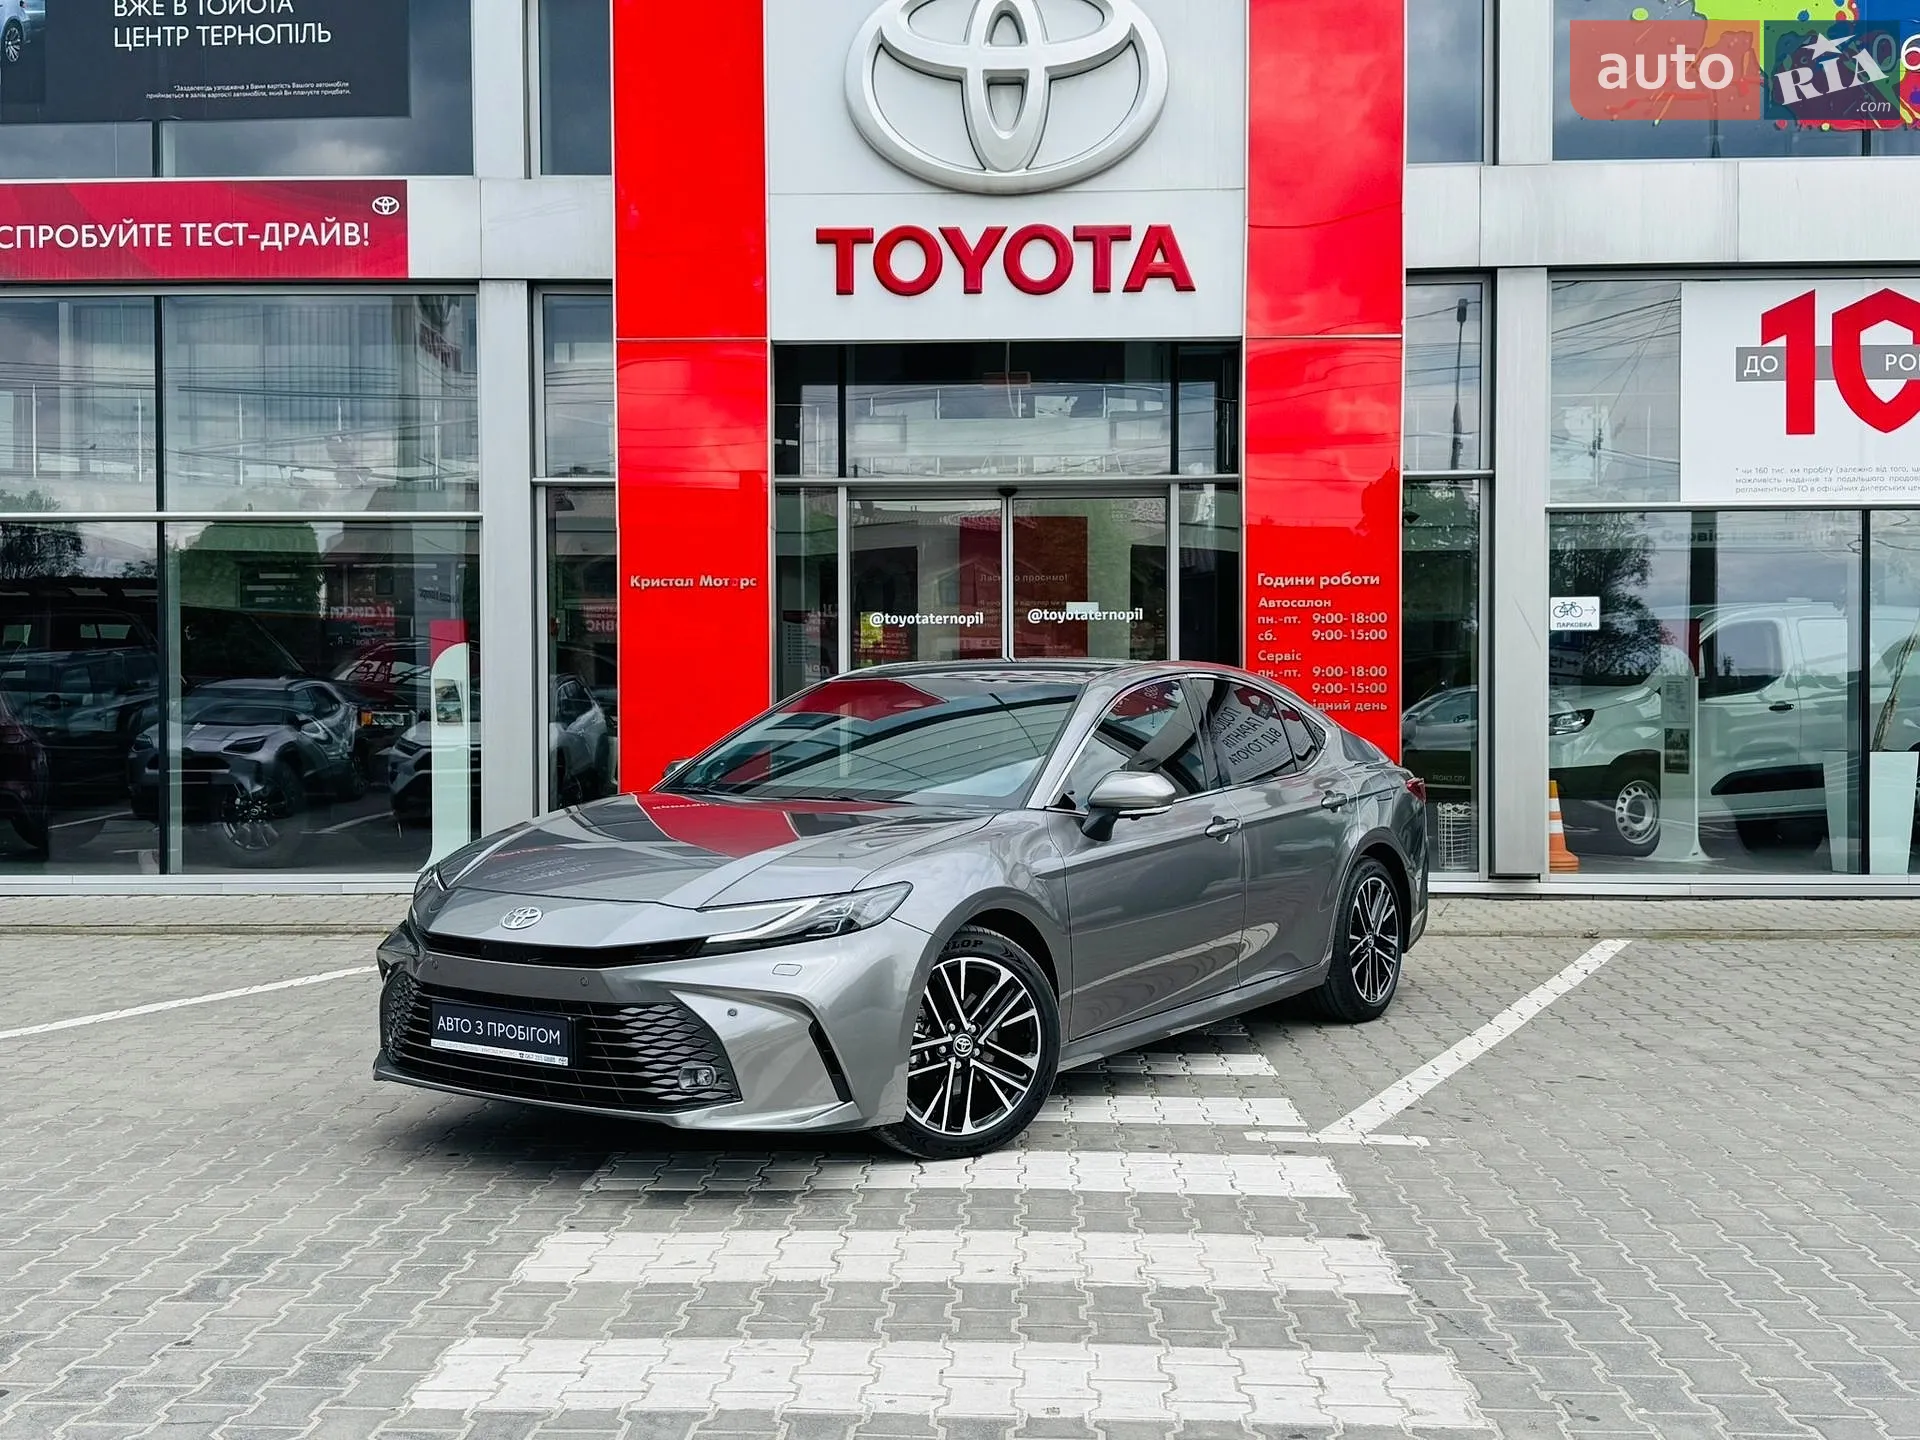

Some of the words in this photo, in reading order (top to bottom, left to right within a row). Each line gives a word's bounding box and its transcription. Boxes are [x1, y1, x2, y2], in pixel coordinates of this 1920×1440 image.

[114, 0, 165, 17] ВЖЕ
[173, 0, 188, 16] В
[114, 26, 190, 52] ЦЕНТР
[196, 23, 332, 47] ТЕРНОПІЛЬ
[0, 218, 173, 249] СПРОБУЙТЕ
[180, 216, 371, 252] ТЕСТ-ДРАЙВ!
[816, 223, 1197, 297] TOYOTA
[1743, 355, 1779, 377] ДО
[1761, 287, 1920, 436] 10
[1885, 353, 1920, 371] РО
[629, 575, 694, 590] Кристал
[1257, 572, 1315, 588] Години
[1319, 571, 1380, 589] роботи
[1257, 597, 1332, 608] Автосалон
[869, 611, 984, 627] @toyotaternopil
[1027, 607, 1144, 624] @toyotaternopil
[1312, 612, 1388, 624] 9:00-18:00
[1556, 621, 1593, 629] ПАРКОВКА
[1257, 629, 1278, 641] сб.
[1311, 629, 1388, 641] 9:00-15:00
[1257, 649, 1302, 664] Сервіс
[1312, 665, 1388, 678] 9:00-18:00
[1311, 682, 1388, 694] 9:00-15:00
[1312, 699, 1351, 712] ідний
[1354, 702, 1388, 712] день
[437, 1015, 472, 1034] АВТО
[487, 1021, 561, 1046] ПРОБІГОМ
